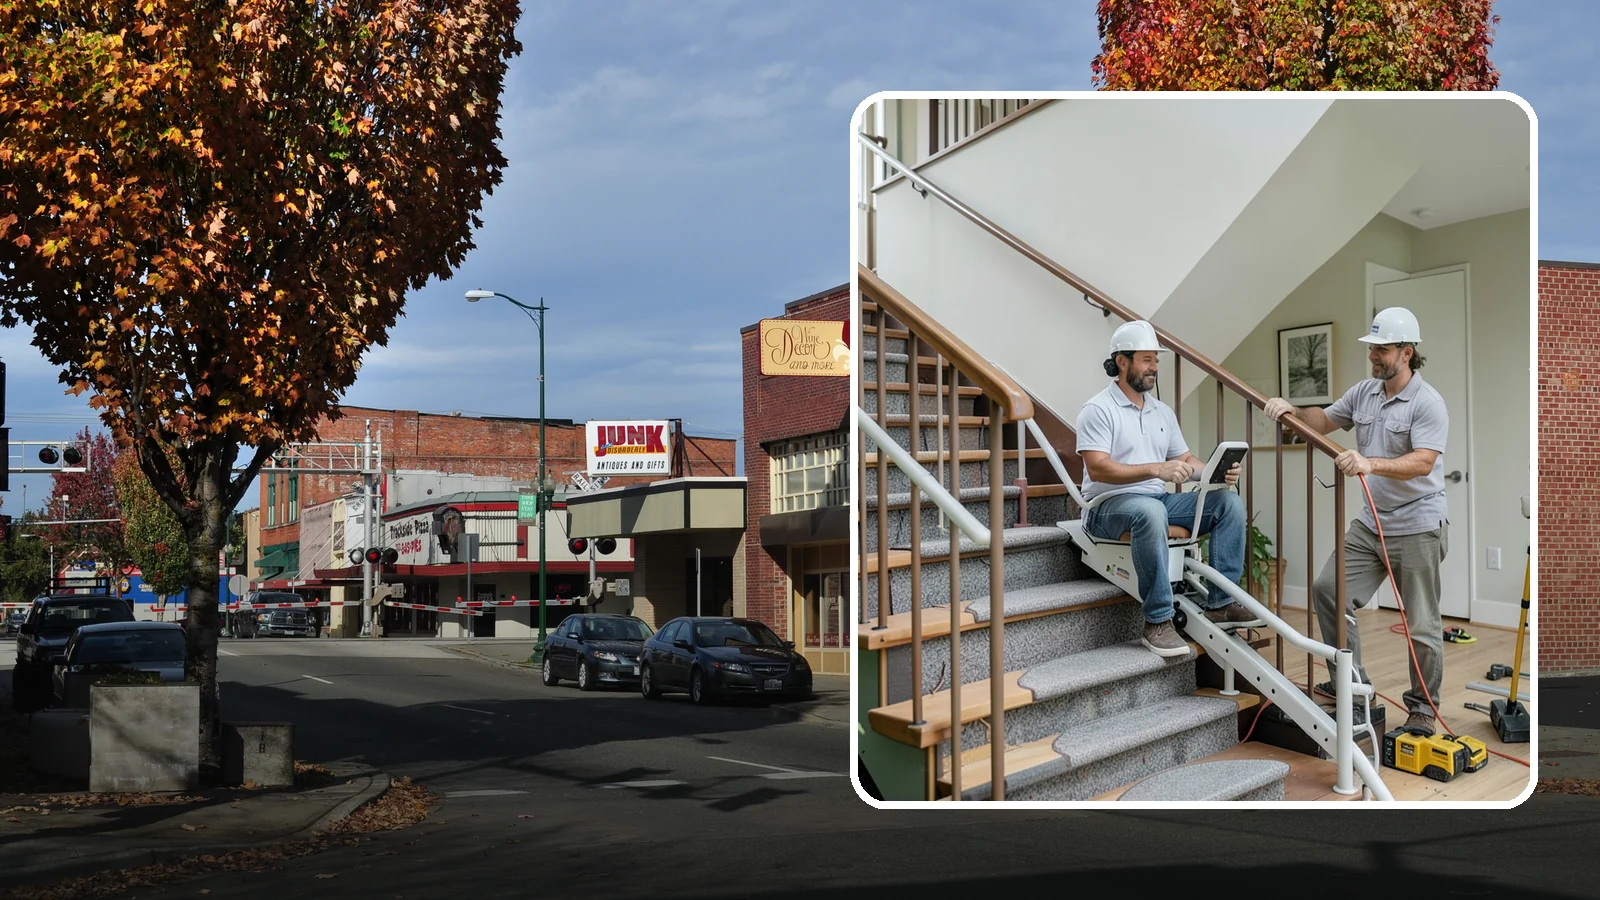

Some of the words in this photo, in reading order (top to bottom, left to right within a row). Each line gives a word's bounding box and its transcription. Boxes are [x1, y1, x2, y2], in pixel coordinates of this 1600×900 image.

[765, 327, 831, 365] Decor
[595, 425, 666, 457] JUNK
[607, 446, 645, 454] DISORDERLY
[597, 461, 628, 470] ANTIQUES
[631, 461, 643, 470] AND
[647, 460, 665, 470] GIFTS
[390, 521, 412, 539] Trackside
[414, 519, 428, 535] Pizza
